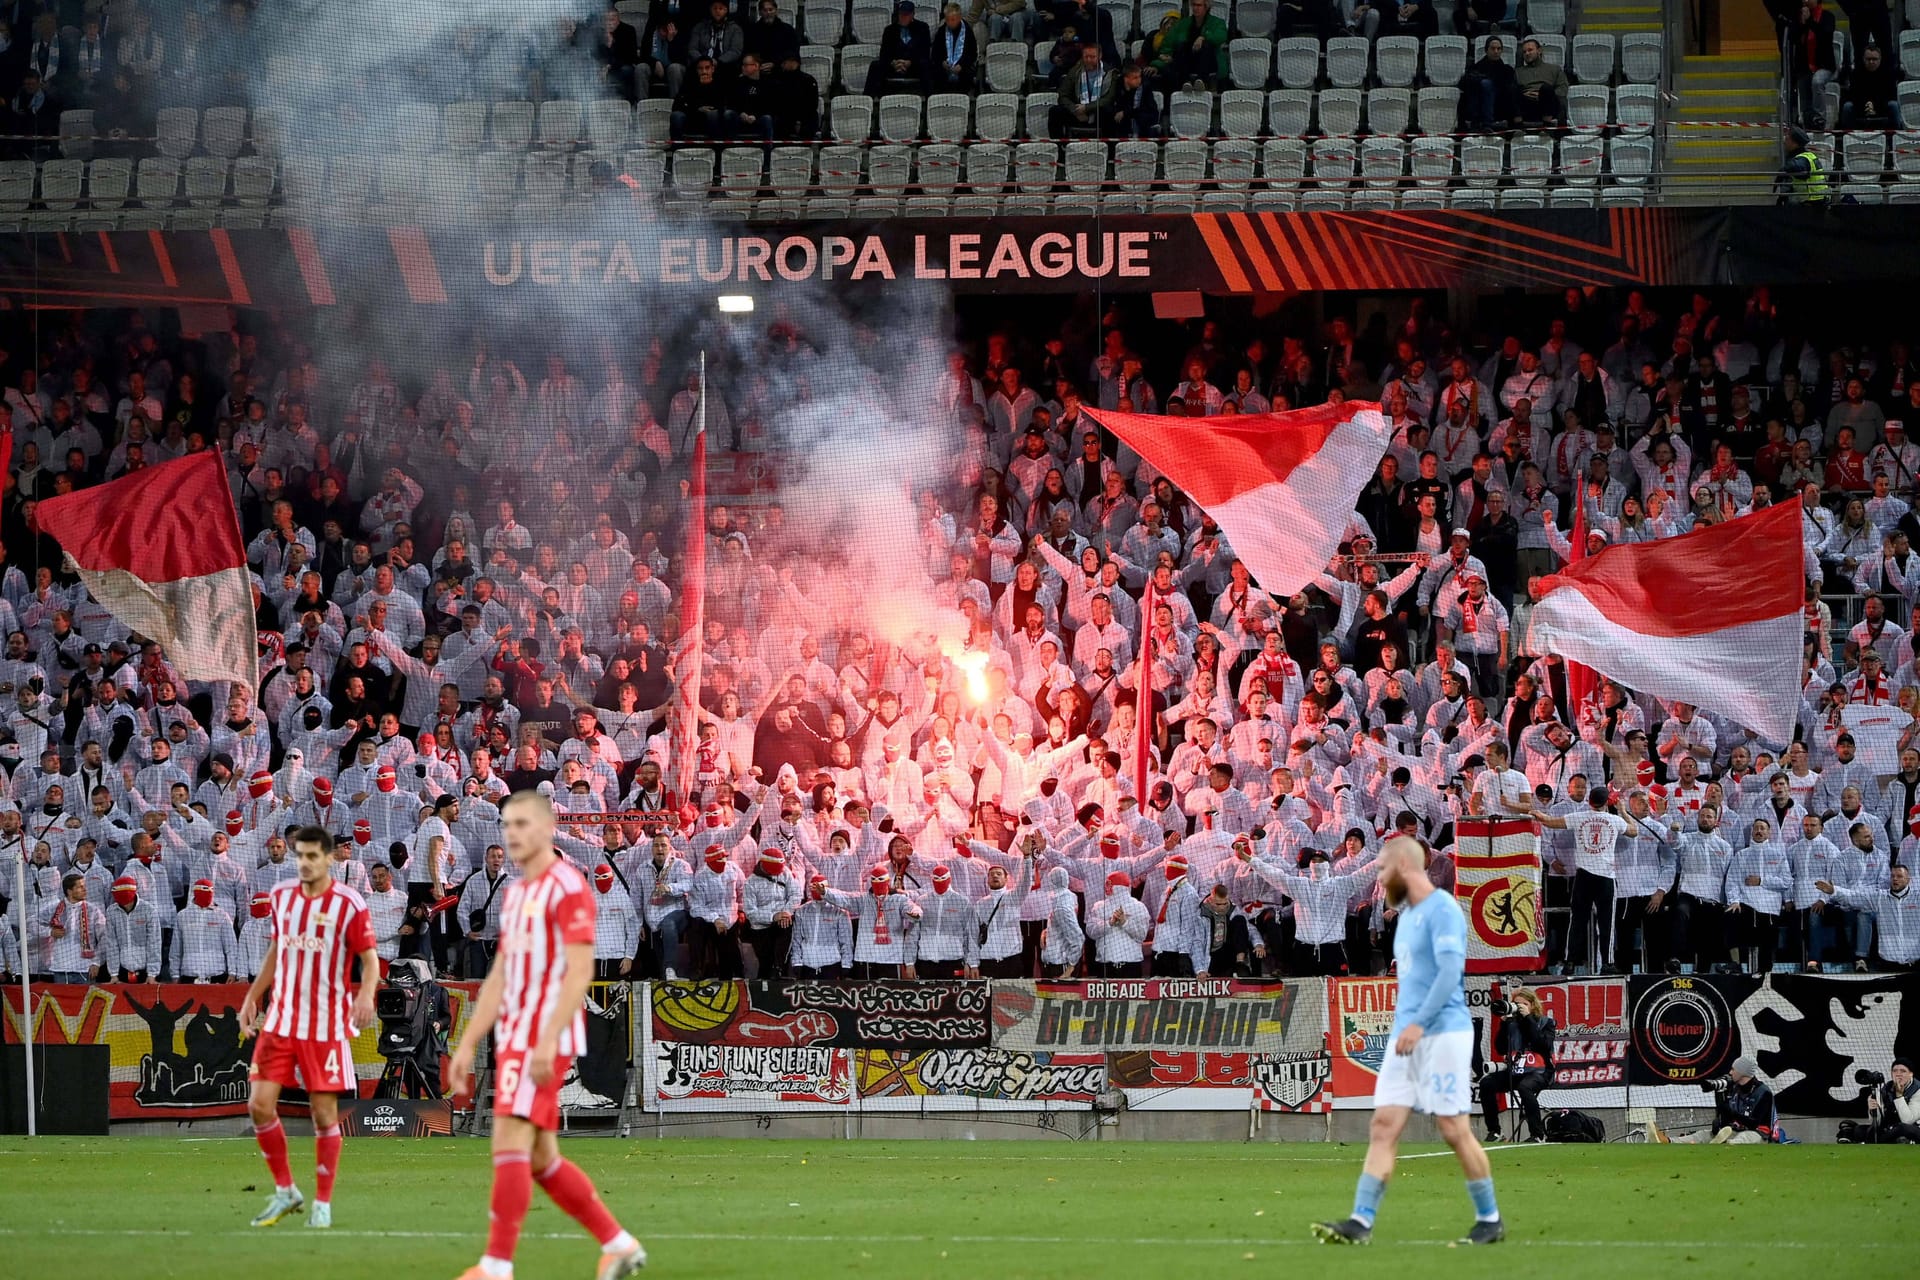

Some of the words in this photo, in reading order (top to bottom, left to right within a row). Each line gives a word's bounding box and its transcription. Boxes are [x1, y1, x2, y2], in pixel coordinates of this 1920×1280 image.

[484, 239, 641, 286] UEFA
[659, 235, 894, 283] EUROPA
[914, 231, 1151, 279] LEAGUE
[1087, 982, 1146, 999] BRIGADE
[1158, 979, 1231, 999] KÖPENICK
[325, 1050, 340, 1074] 4
[678, 1045, 720, 1074] EINS
[769, 1047, 831, 1077] SIEBEN
[1257, 1059, 1329, 1082] PLATTE
[500, 1059, 521, 1094] 6
[919, 1050, 1002, 1091] Oder
[1002, 1055, 1106, 1099] Spree
[1432, 1072, 1457, 1093] 32
[1555, 1066, 1622, 1083] enick
[363, 1116, 405, 1125] EUROPA
[374, 1105, 395, 1115] UEFA
[755, 1115, 771, 1130] 79
[1037, 1113, 1055, 1134] 80
